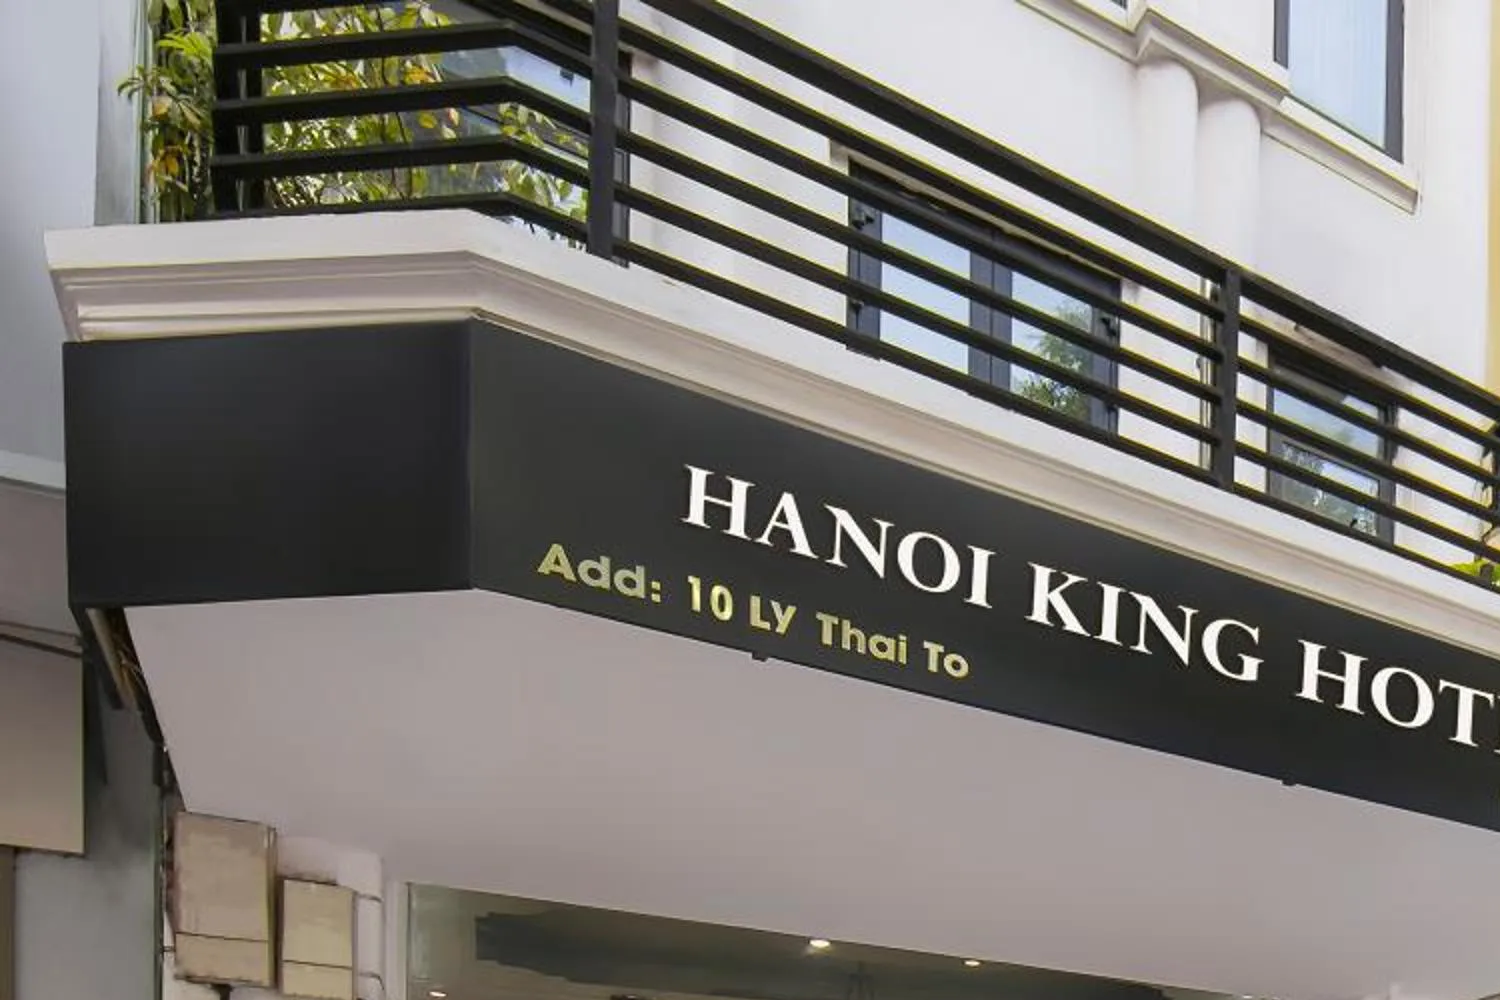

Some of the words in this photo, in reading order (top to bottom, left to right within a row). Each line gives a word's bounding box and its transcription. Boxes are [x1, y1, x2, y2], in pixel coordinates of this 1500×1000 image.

[537, 543, 662, 603] Add:
[687, 575, 733, 622] 10
[815, 611, 907, 665] Thai
[922, 641, 970, 680] To
[681, 464, 996, 609] HANOI
[1024, 562, 1264, 682] KING
